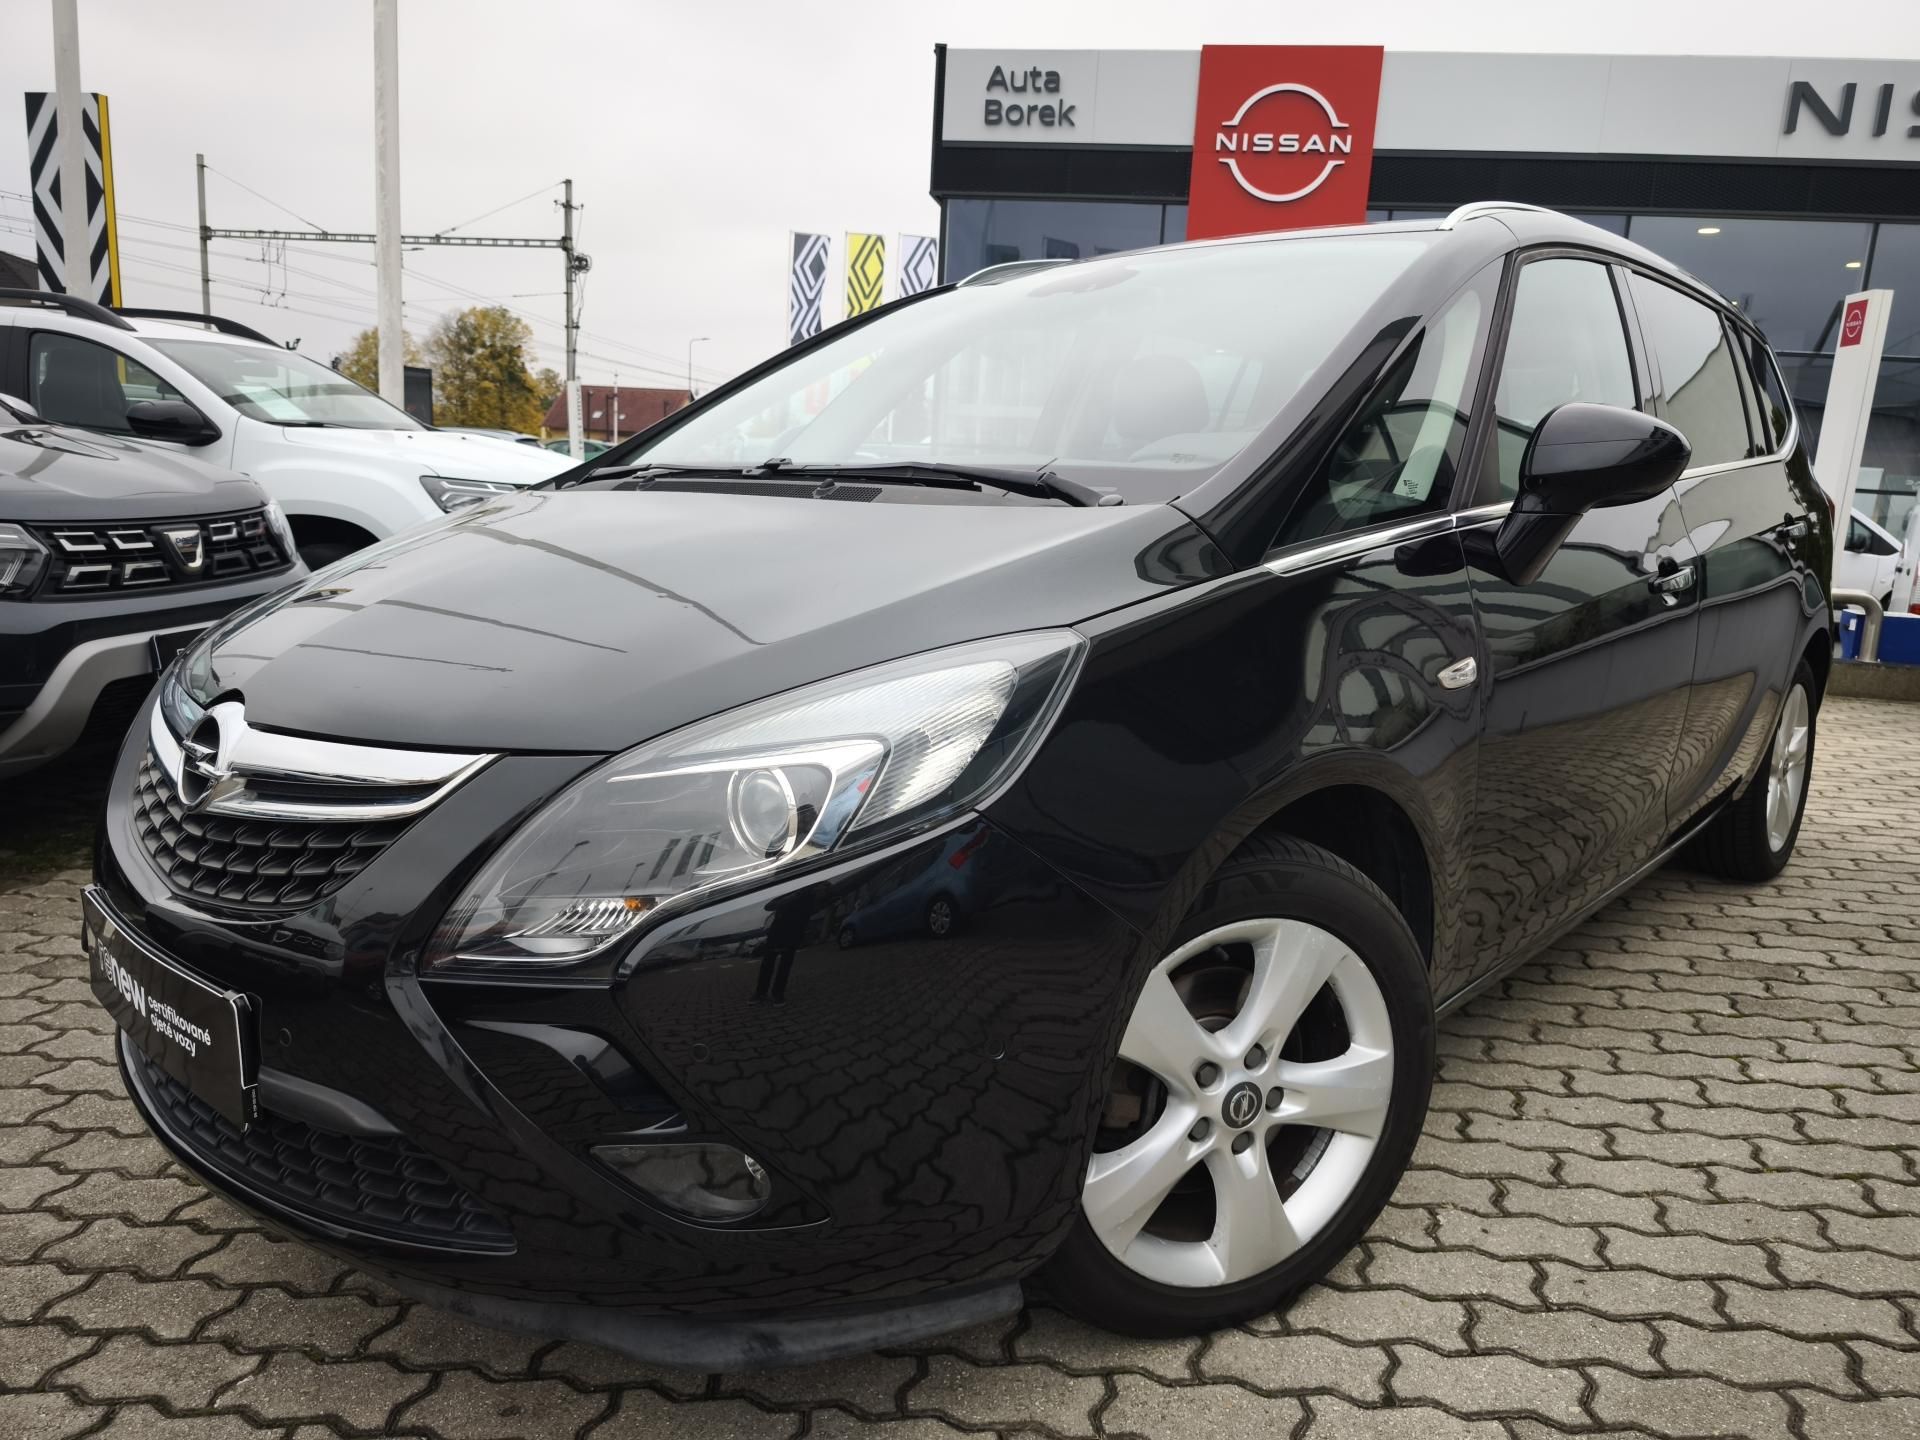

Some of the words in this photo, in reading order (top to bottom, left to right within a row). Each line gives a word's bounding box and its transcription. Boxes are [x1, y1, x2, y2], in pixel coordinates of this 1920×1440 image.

[986, 65, 1060, 93] Auta
[985, 99, 1076, 127] Borek
[1784, 81, 1920, 138] NI
[1215, 132, 1353, 154] NISSAN
[148, 995, 211, 1046] certifikované
[150, 1012, 173, 1039] ojeté
[173, 1029, 196, 1057] vozy
